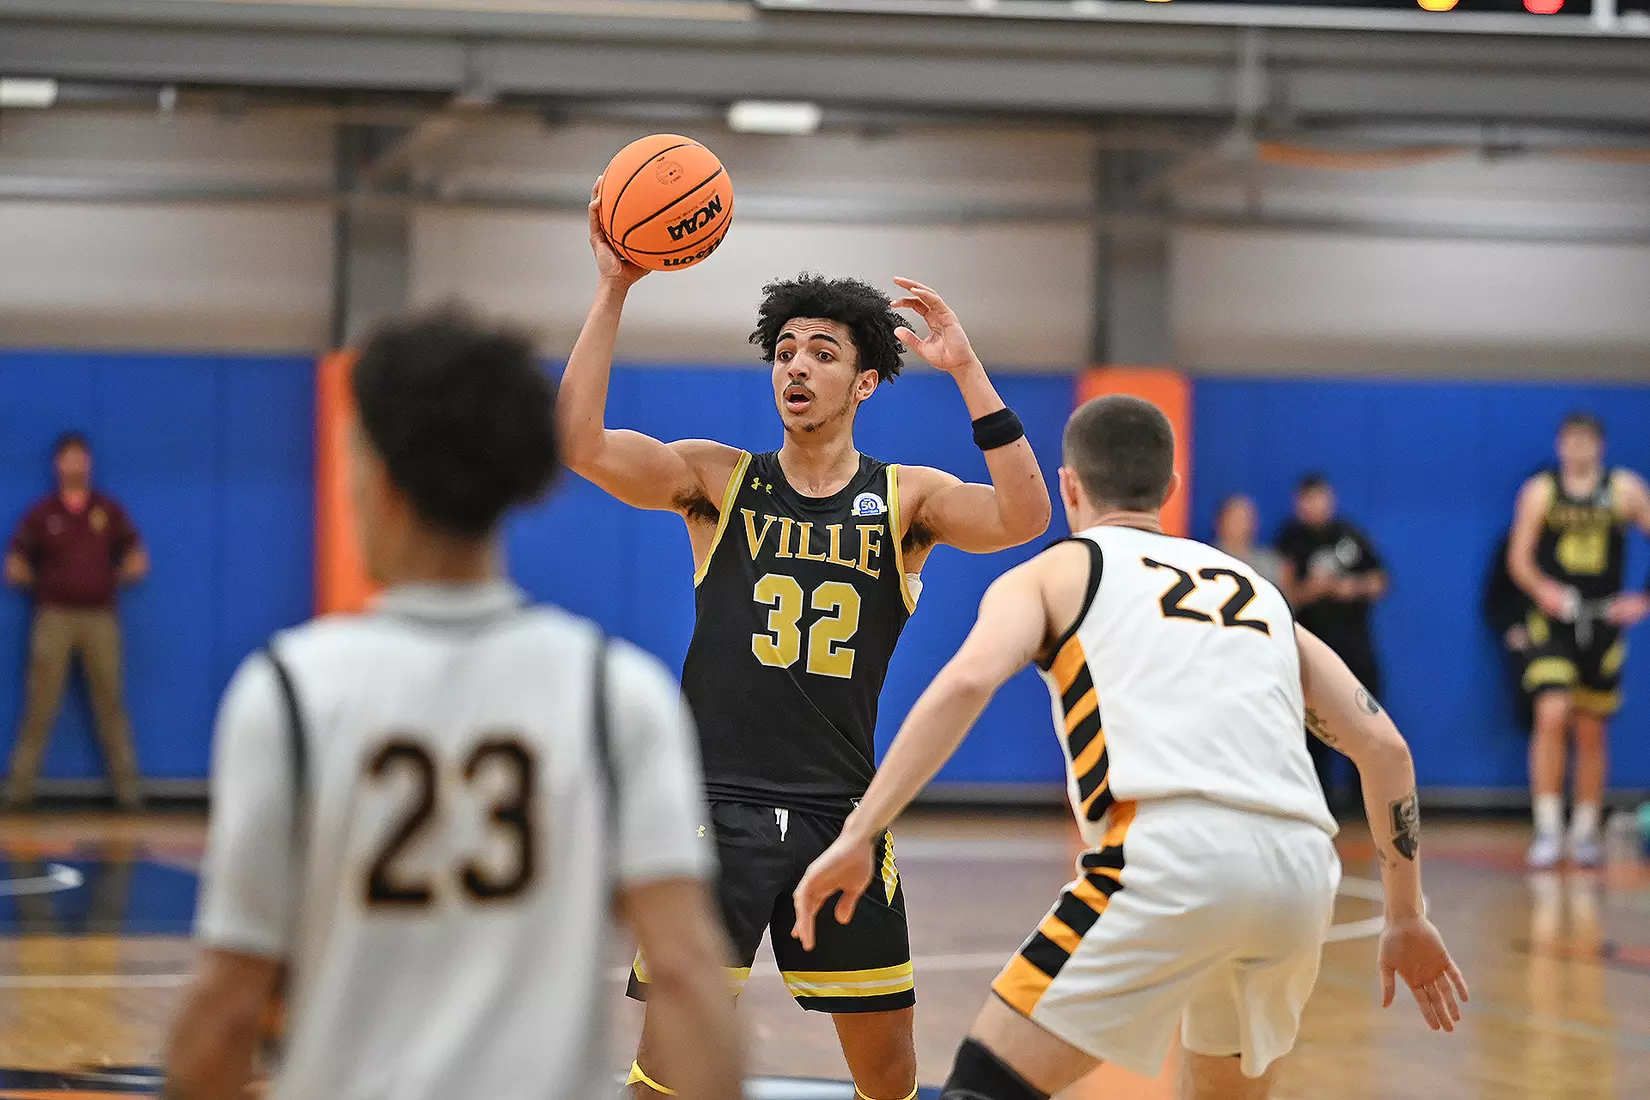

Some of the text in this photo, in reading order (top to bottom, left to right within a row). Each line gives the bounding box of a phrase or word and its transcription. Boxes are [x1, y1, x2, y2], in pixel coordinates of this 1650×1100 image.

[663, 224, 730, 266] son
[667, 194, 722, 241] NCAA
[861, 500, 877, 511] 50
[740, 507, 884, 580] VILLE
[751, 572, 862, 679] 32
[1140, 555, 1272, 638] 22
[362, 737, 540, 906] 23
